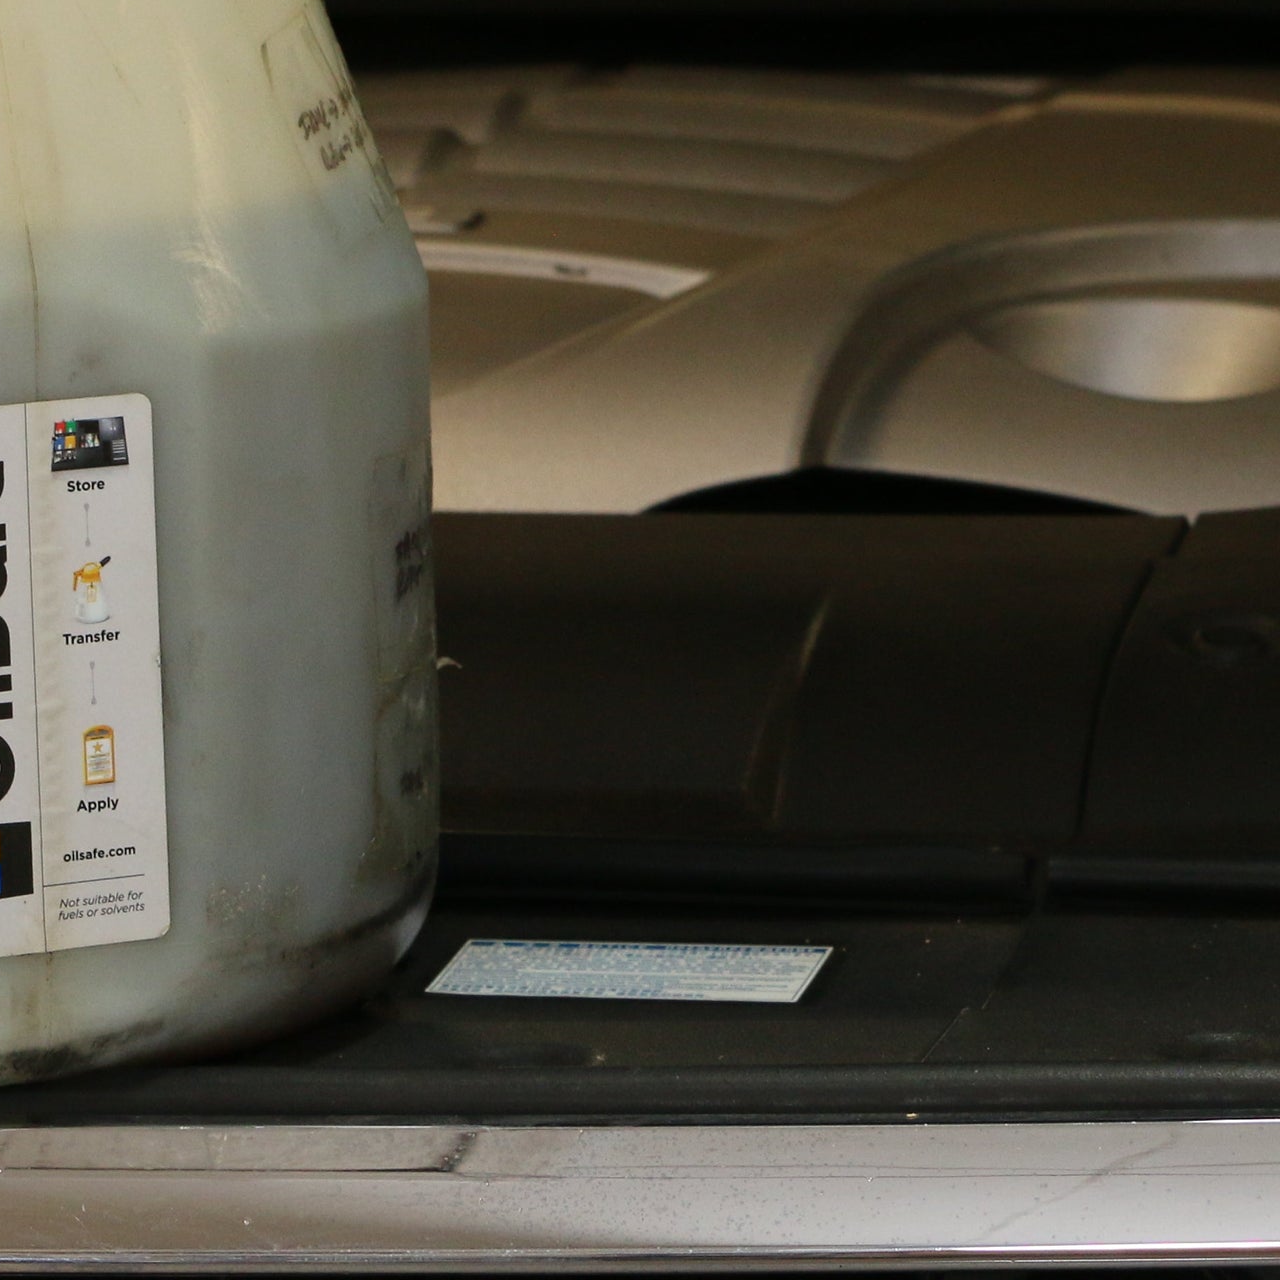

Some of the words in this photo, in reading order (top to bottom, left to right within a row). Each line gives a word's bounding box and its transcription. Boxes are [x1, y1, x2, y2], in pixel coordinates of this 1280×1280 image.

[66, 477, 106, 493] Store
[62, 628, 121, 646] Transfer
[76, 796, 119, 814] Apply
[63, 846, 136, 862] oilsafe.com
[59, 898, 80, 909] Not
[83, 892, 125, 906] suitable
[127, 890, 144, 901] for
[58, 909, 84, 921] fuels
[86, 908, 99, 917] or
[100, 902, 145, 916] solvents
